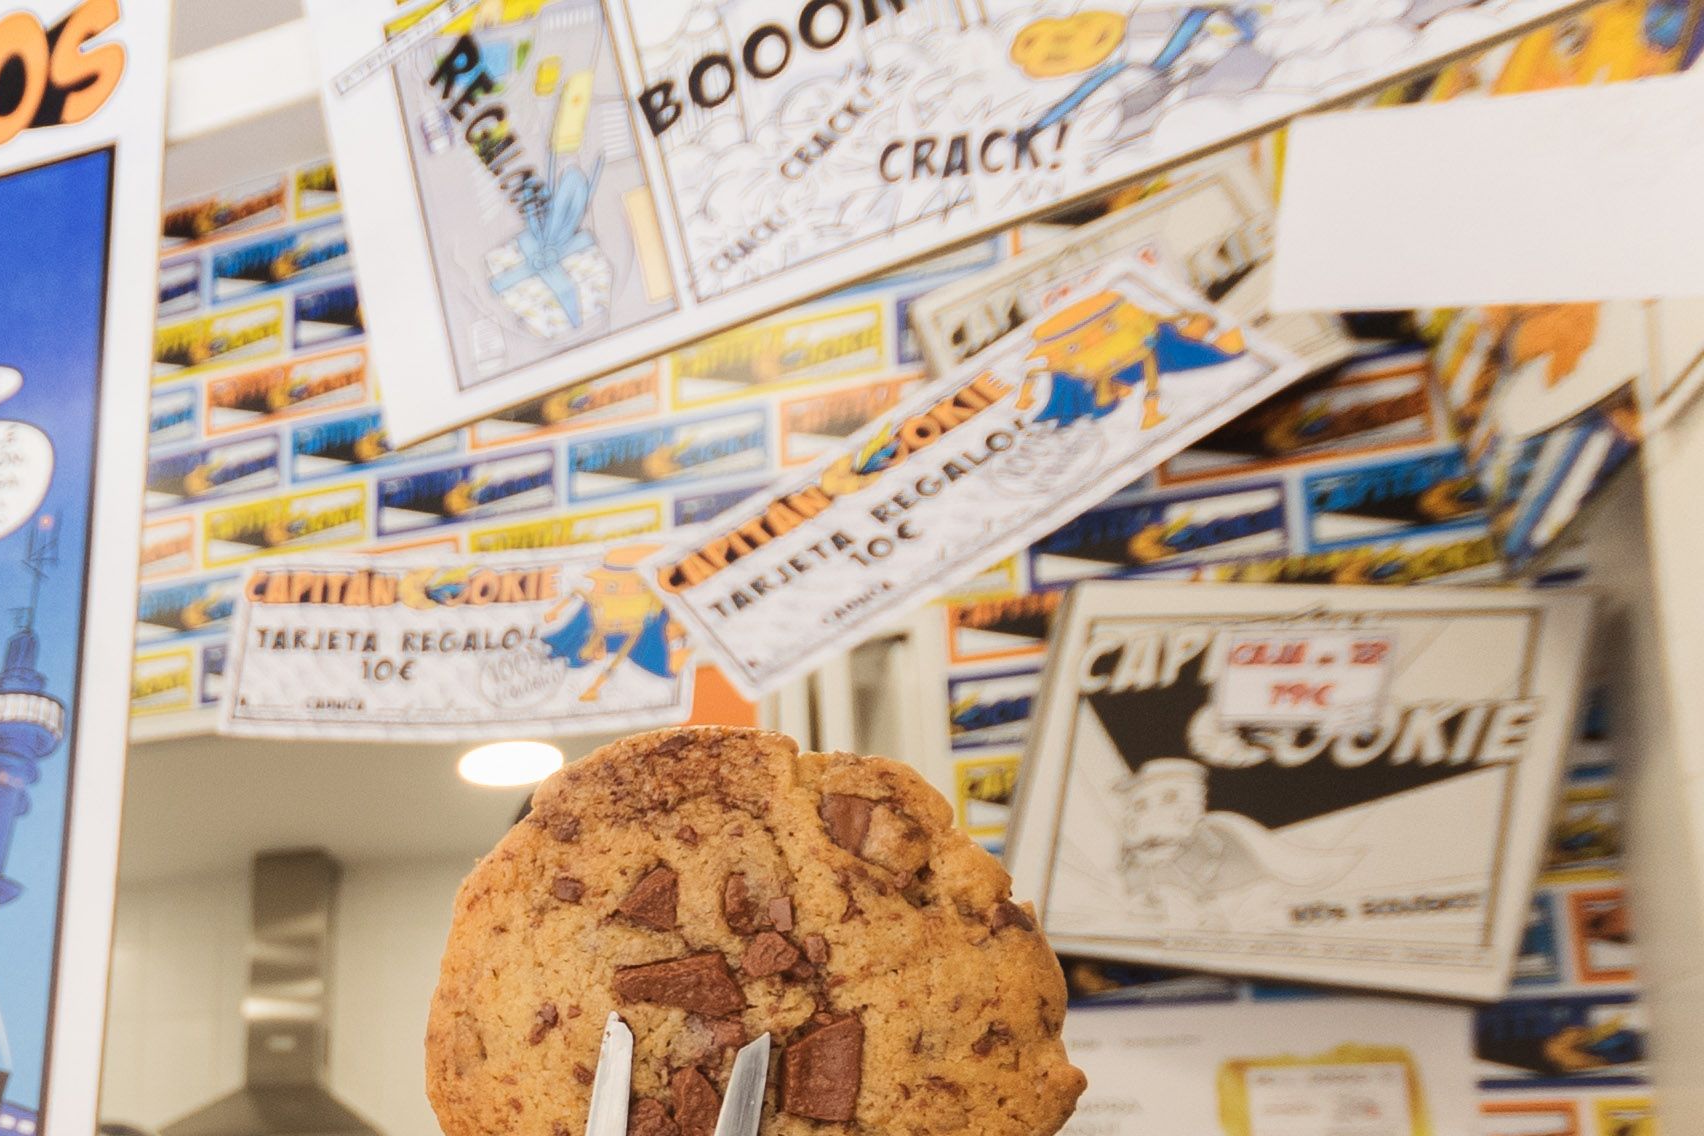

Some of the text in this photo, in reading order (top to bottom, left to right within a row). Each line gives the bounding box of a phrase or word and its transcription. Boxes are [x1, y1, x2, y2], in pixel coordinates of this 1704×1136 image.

[880, 123, 1069, 186] CRACK!
[246, 568, 397, 606] CAPITÁN
[709, 530, 855, 619] TARJETA
[256, 628, 380, 652] TARJETA
[1076, 628, 1220, 695] CAPI
[361, 658, 416, 682] 10€
